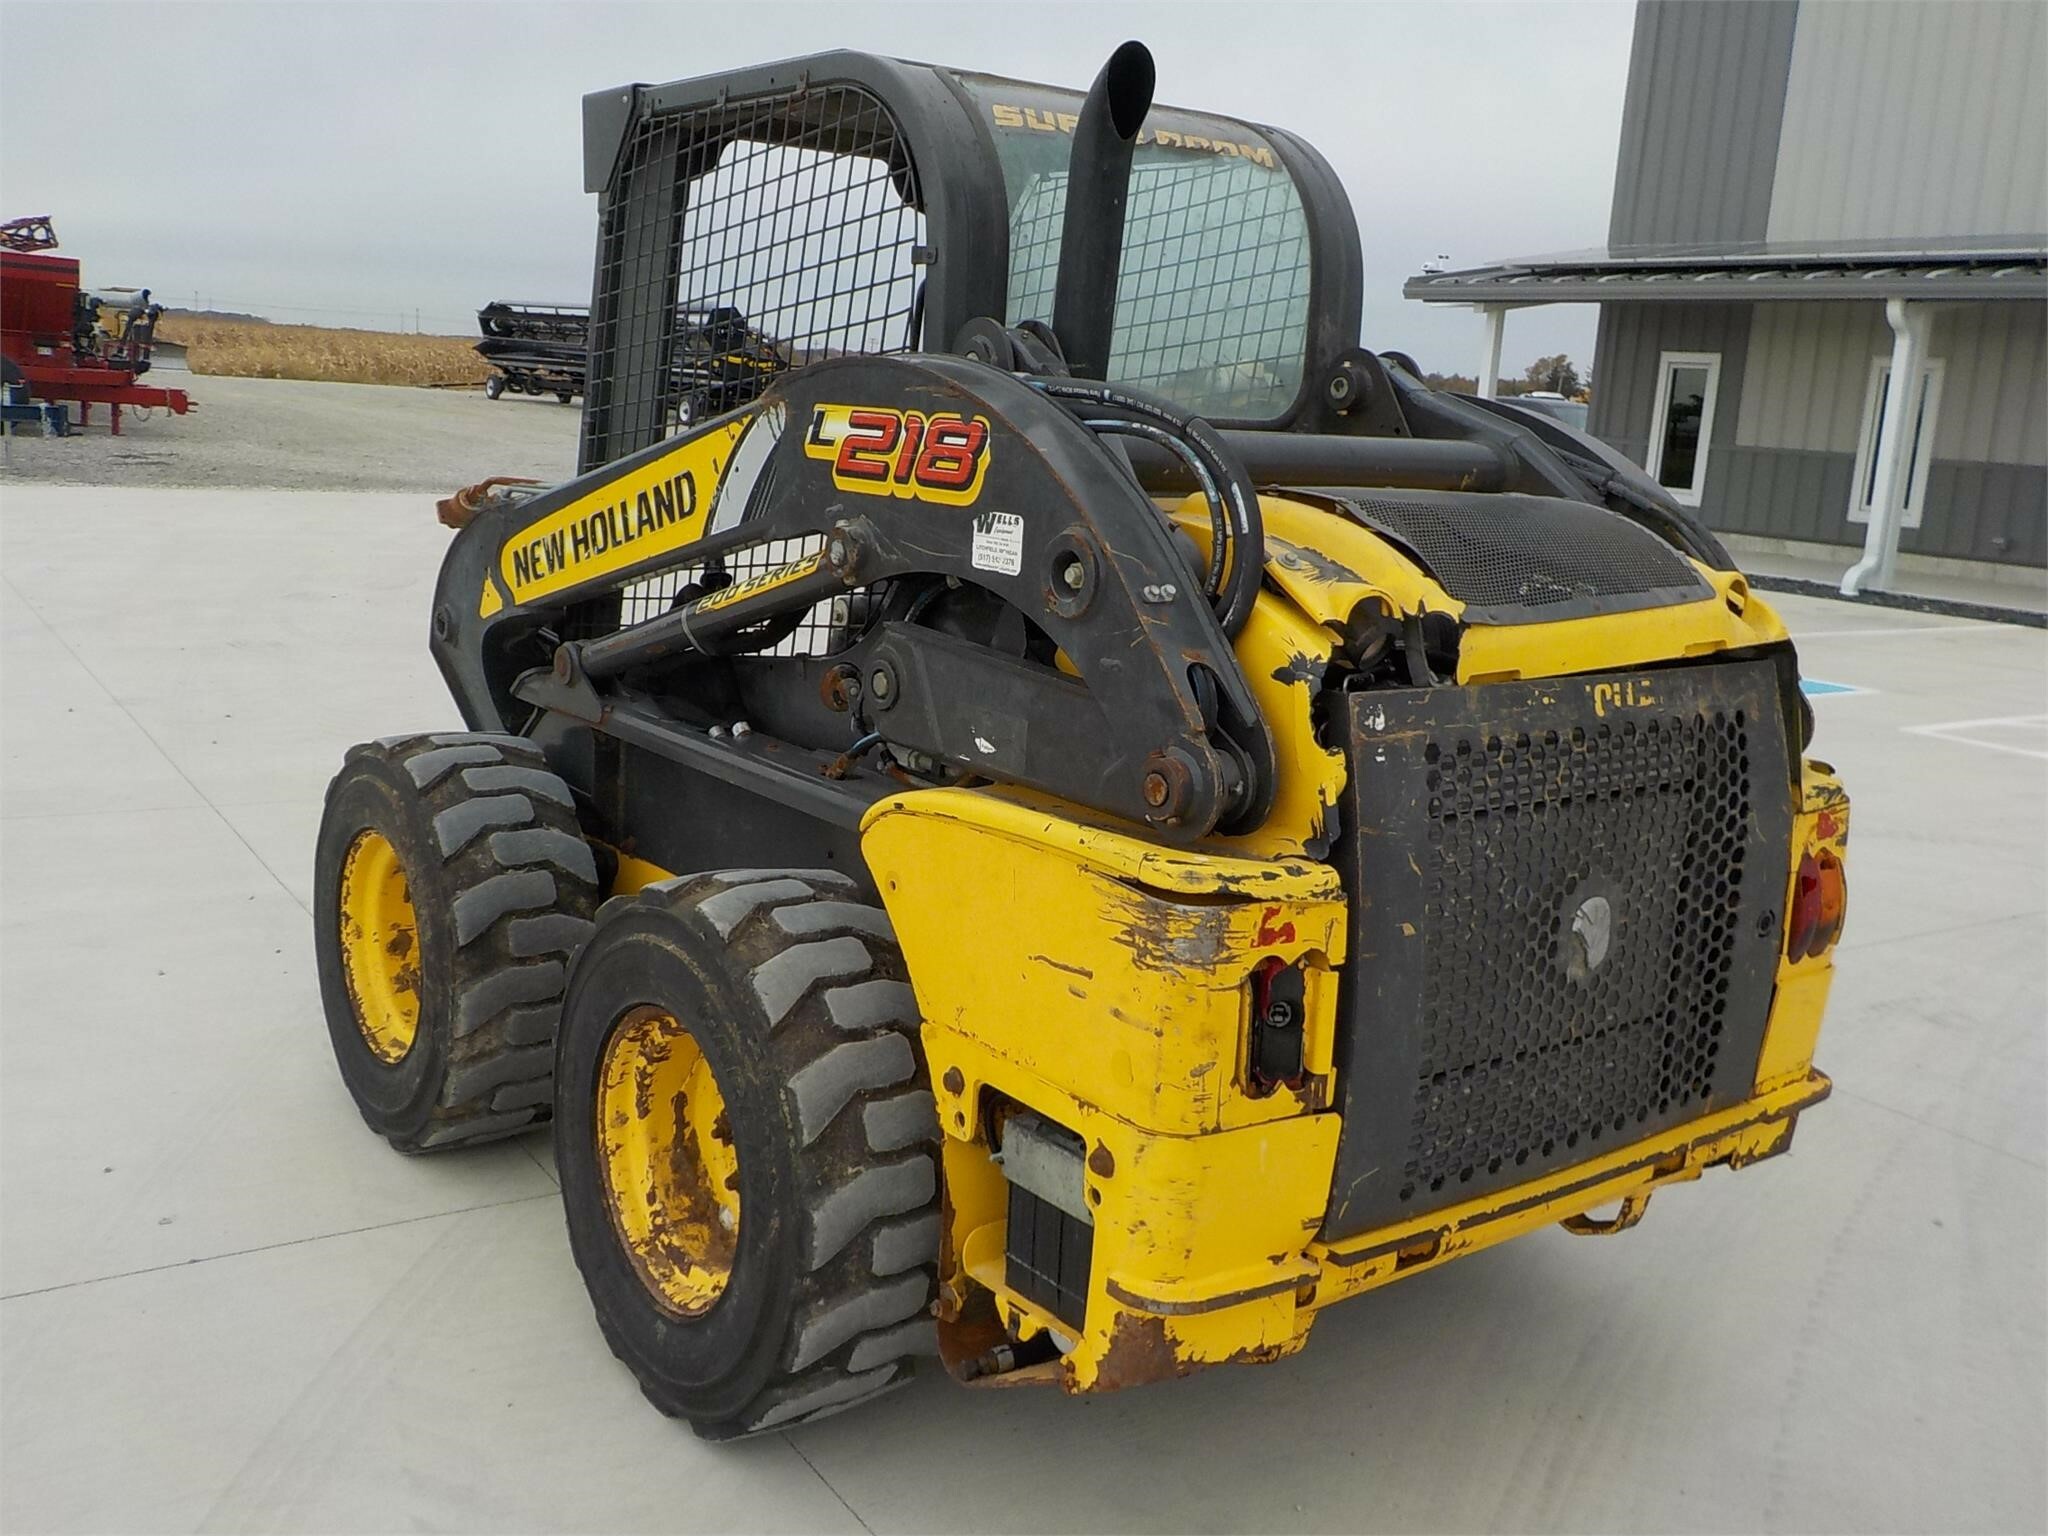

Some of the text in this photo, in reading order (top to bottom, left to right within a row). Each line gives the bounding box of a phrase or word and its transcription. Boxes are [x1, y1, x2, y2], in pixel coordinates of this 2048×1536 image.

[807, 406, 988, 493] L218
[512, 469, 697, 588] NEW HOLLAND
[976, 513, 1020, 535] WELLS
[697, 554, 820, 610] 200 SERIES
